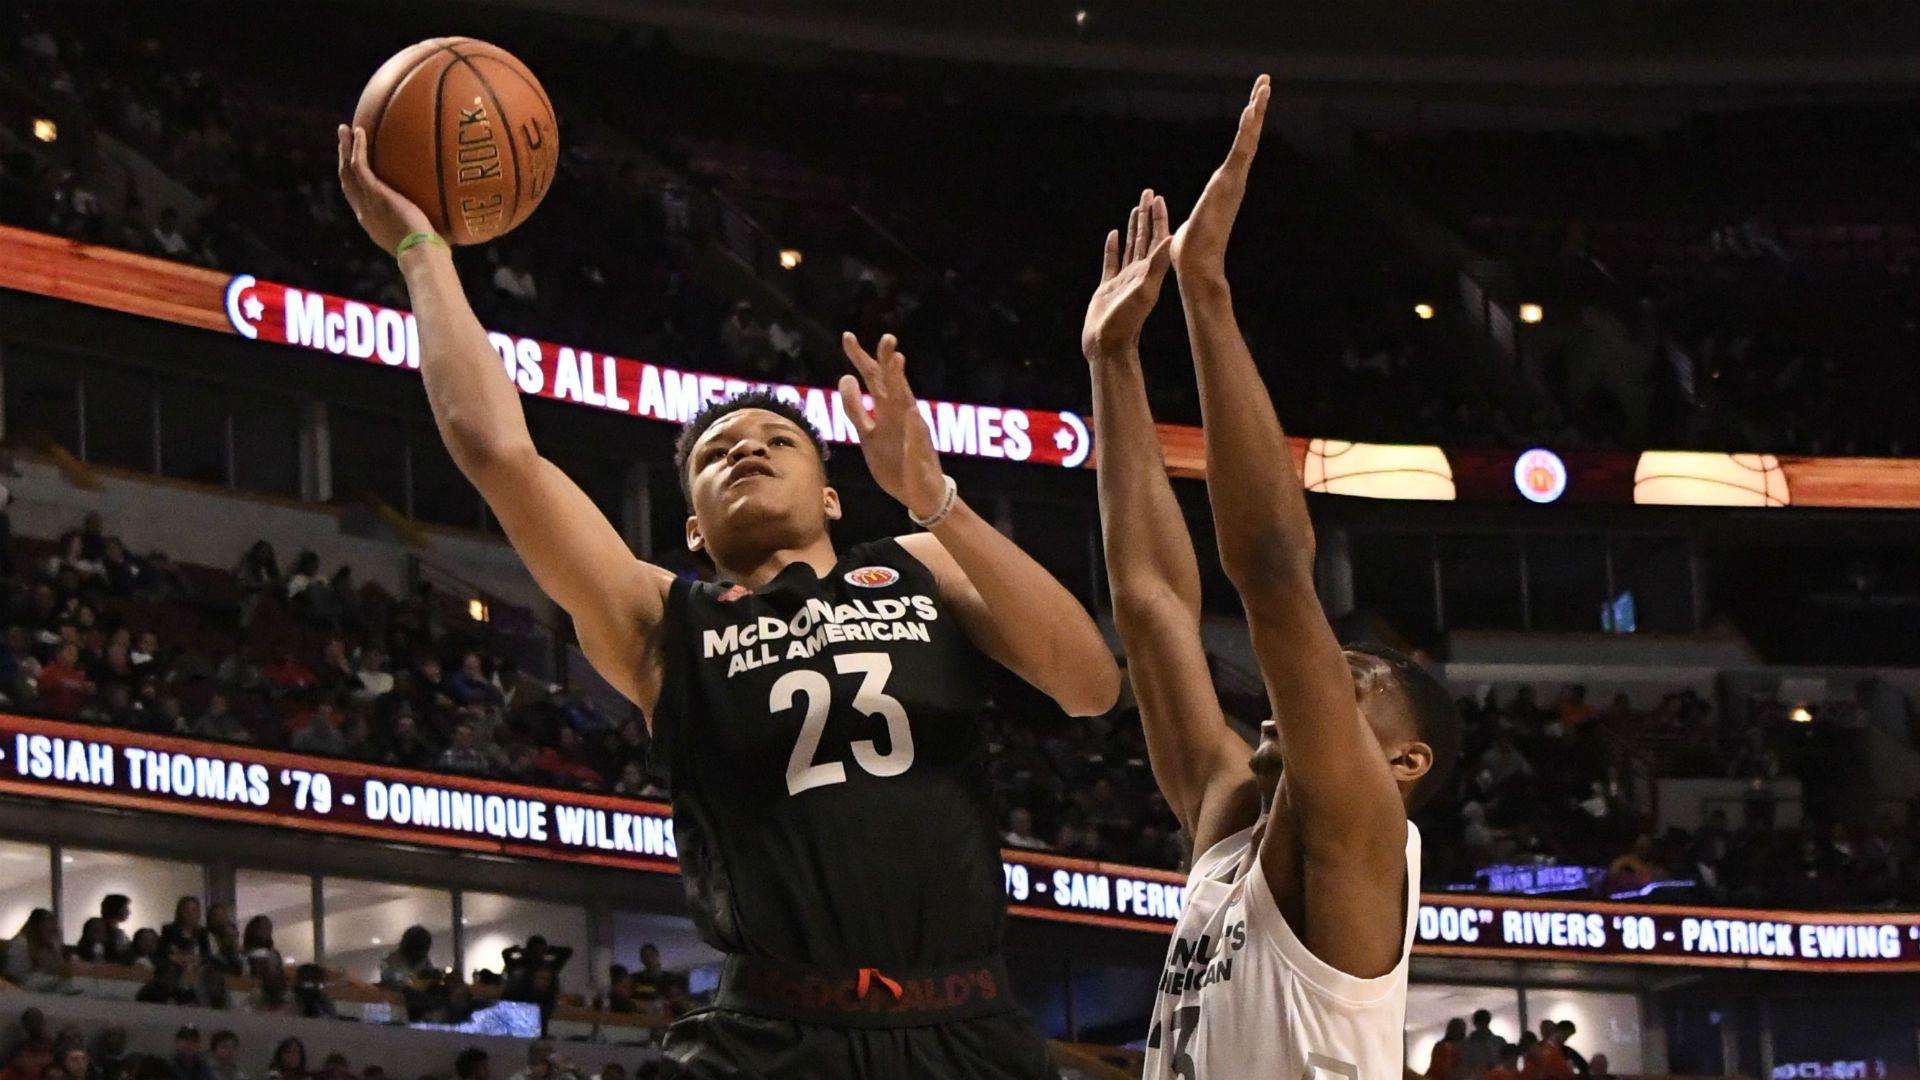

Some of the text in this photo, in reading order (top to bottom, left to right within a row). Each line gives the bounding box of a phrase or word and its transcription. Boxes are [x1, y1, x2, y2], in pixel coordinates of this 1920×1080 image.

[285, 287, 1032, 461] McDODS ALL AMEAN AMES
[703, 595, 938, 658] McDONALD'S
[727, 621, 931, 679] ALL AMERICAN
[769, 652, 915, 796] 23
[16, 733, 114, 786] ISIAH
[124, 747, 270, 806] THOMAS
[364, 779, 548, 842] DOMINIQUE
[554, 804, 678, 858] WILKINS
[1053, 869, 1110, 911] SAM
[1502, 910, 1606, 948] RIVERS
[1681, 918, 1795, 957] PATRICK
[1799, 924, 1901, 959] EWING
